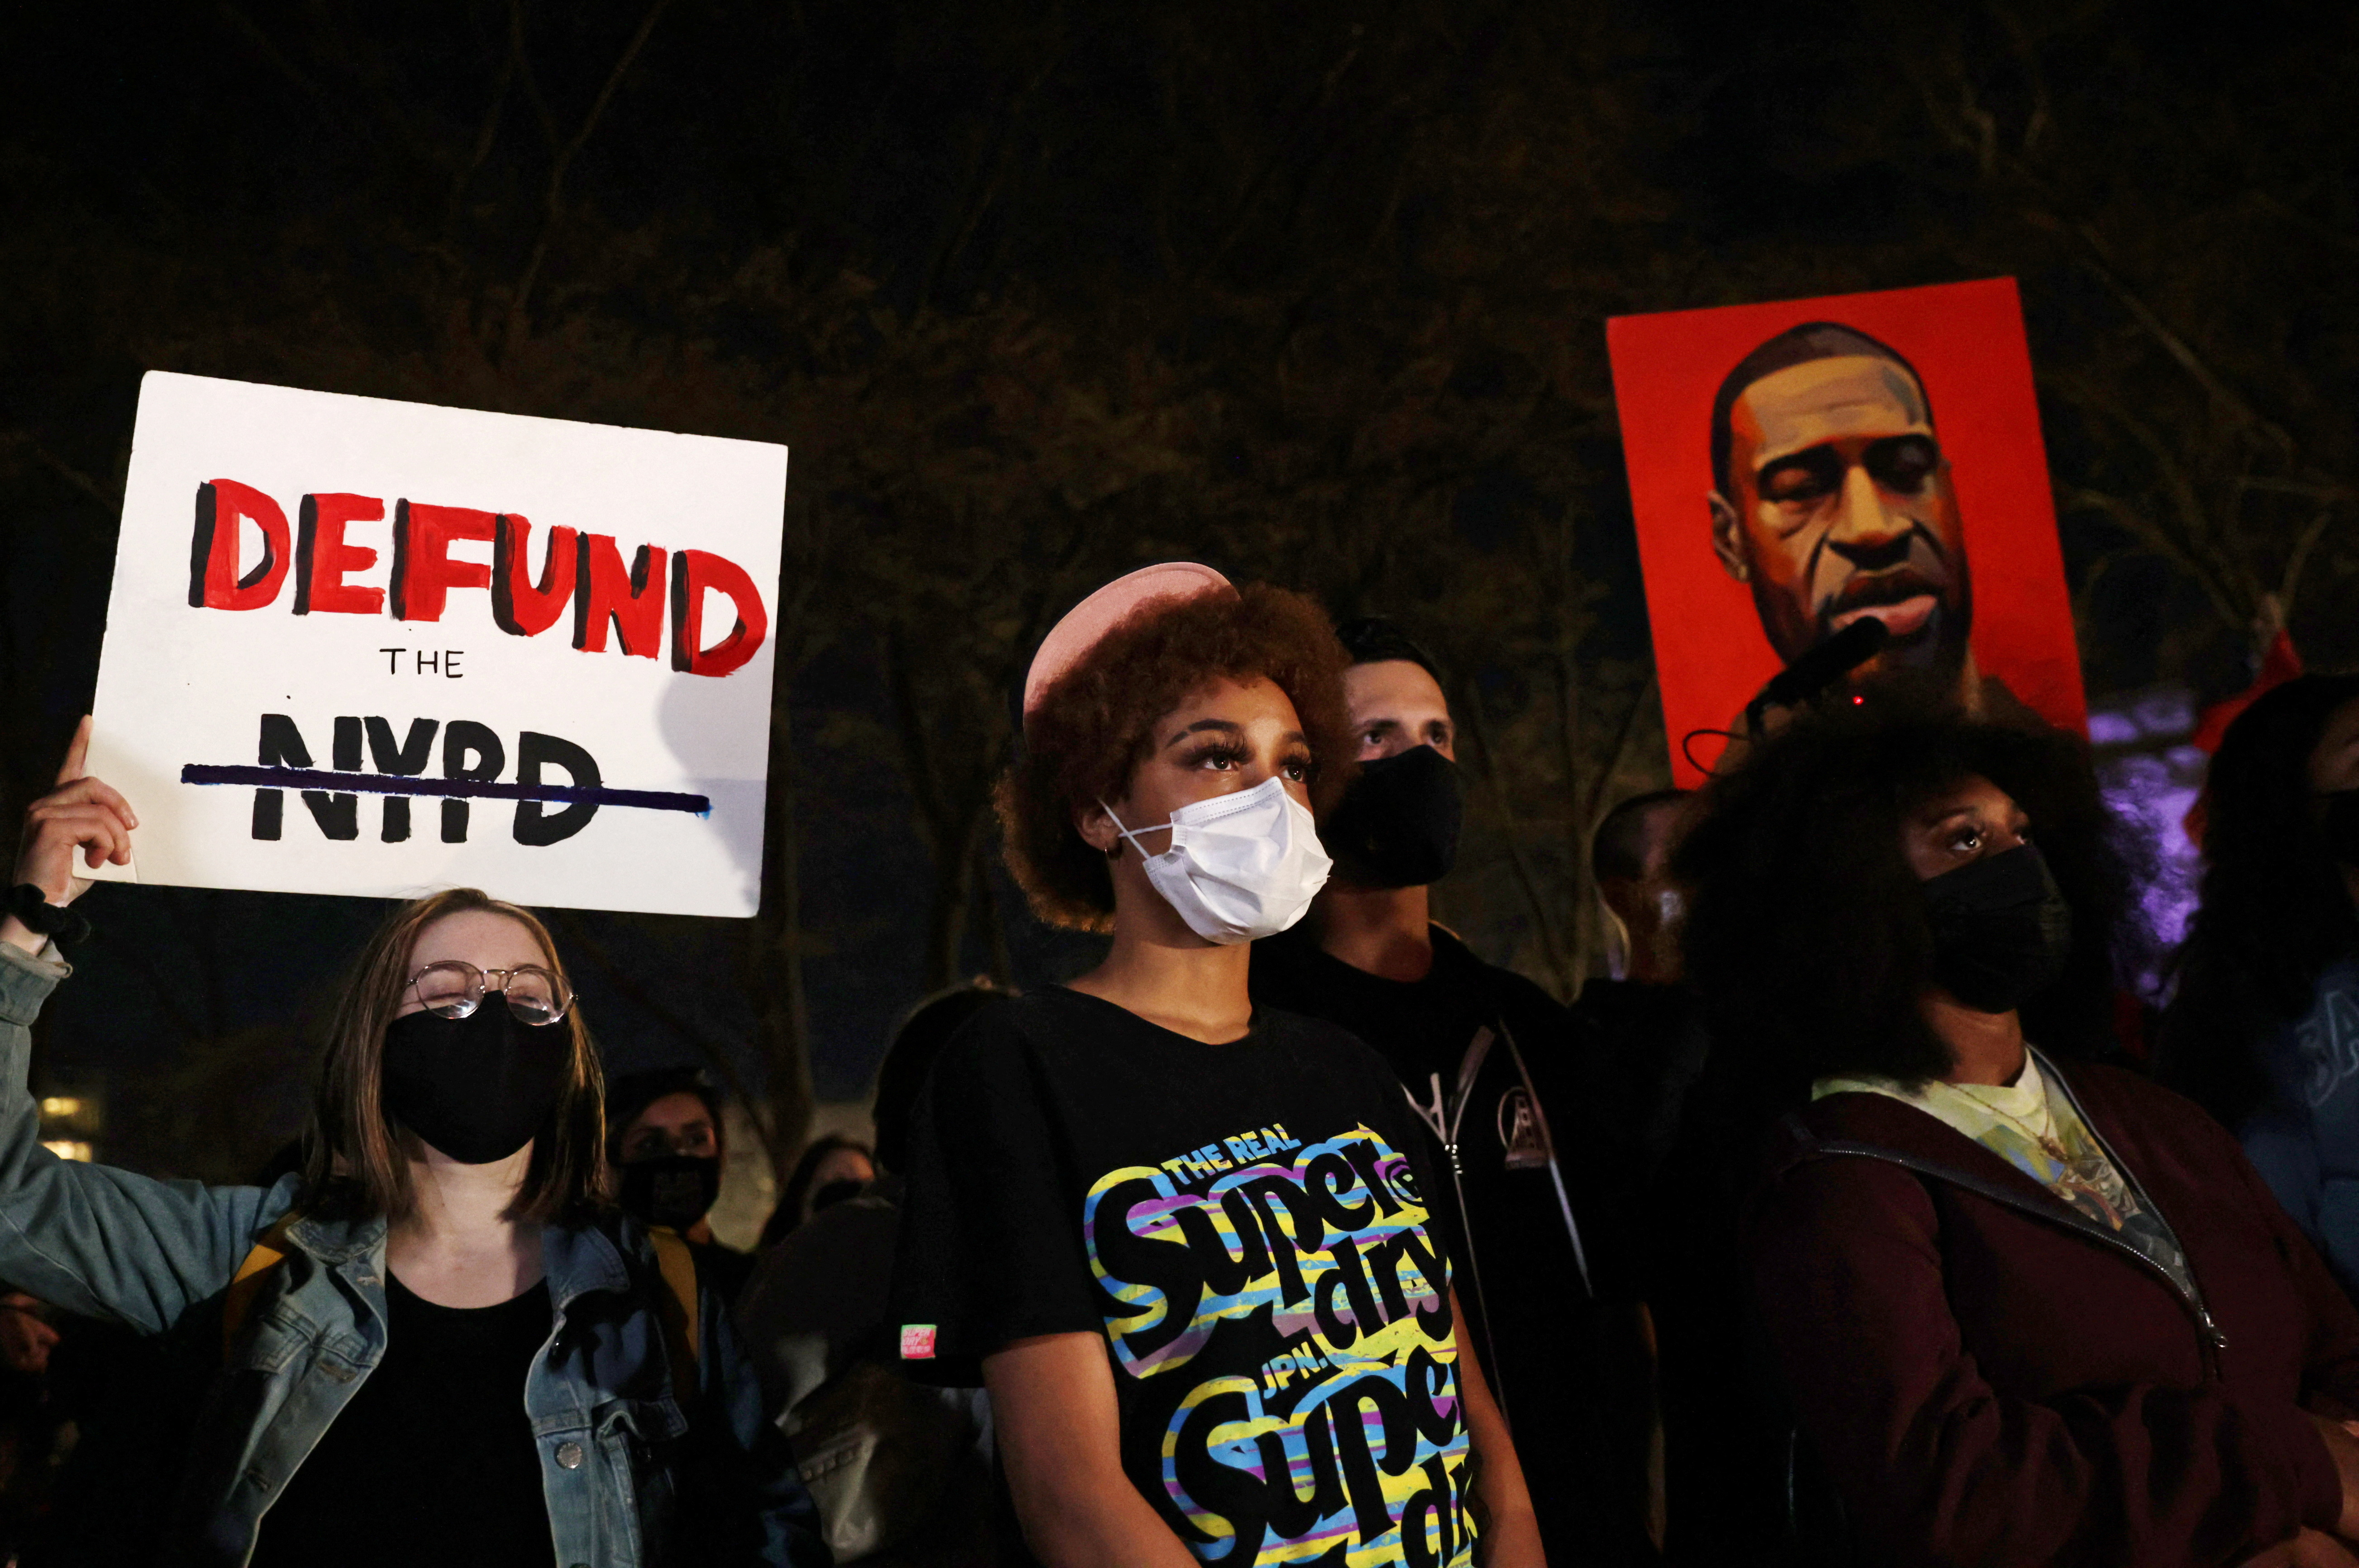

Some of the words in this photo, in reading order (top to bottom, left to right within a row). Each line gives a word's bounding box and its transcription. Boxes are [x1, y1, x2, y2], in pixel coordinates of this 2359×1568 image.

[188, 479, 767, 677] DEFUND
[380, 647, 464, 679] THE
[252, 713, 602, 846] NYPD
[1160, 1143, 1233, 1185] THE
[1223, 1123, 1302, 1164] REAL
[1090, 1134, 1405, 1364] Super
[1314, 1227, 1452, 1350] dry
[1260, 1342, 1329, 1400] JPN.
[1174, 1346, 1468, 1568] Supe
